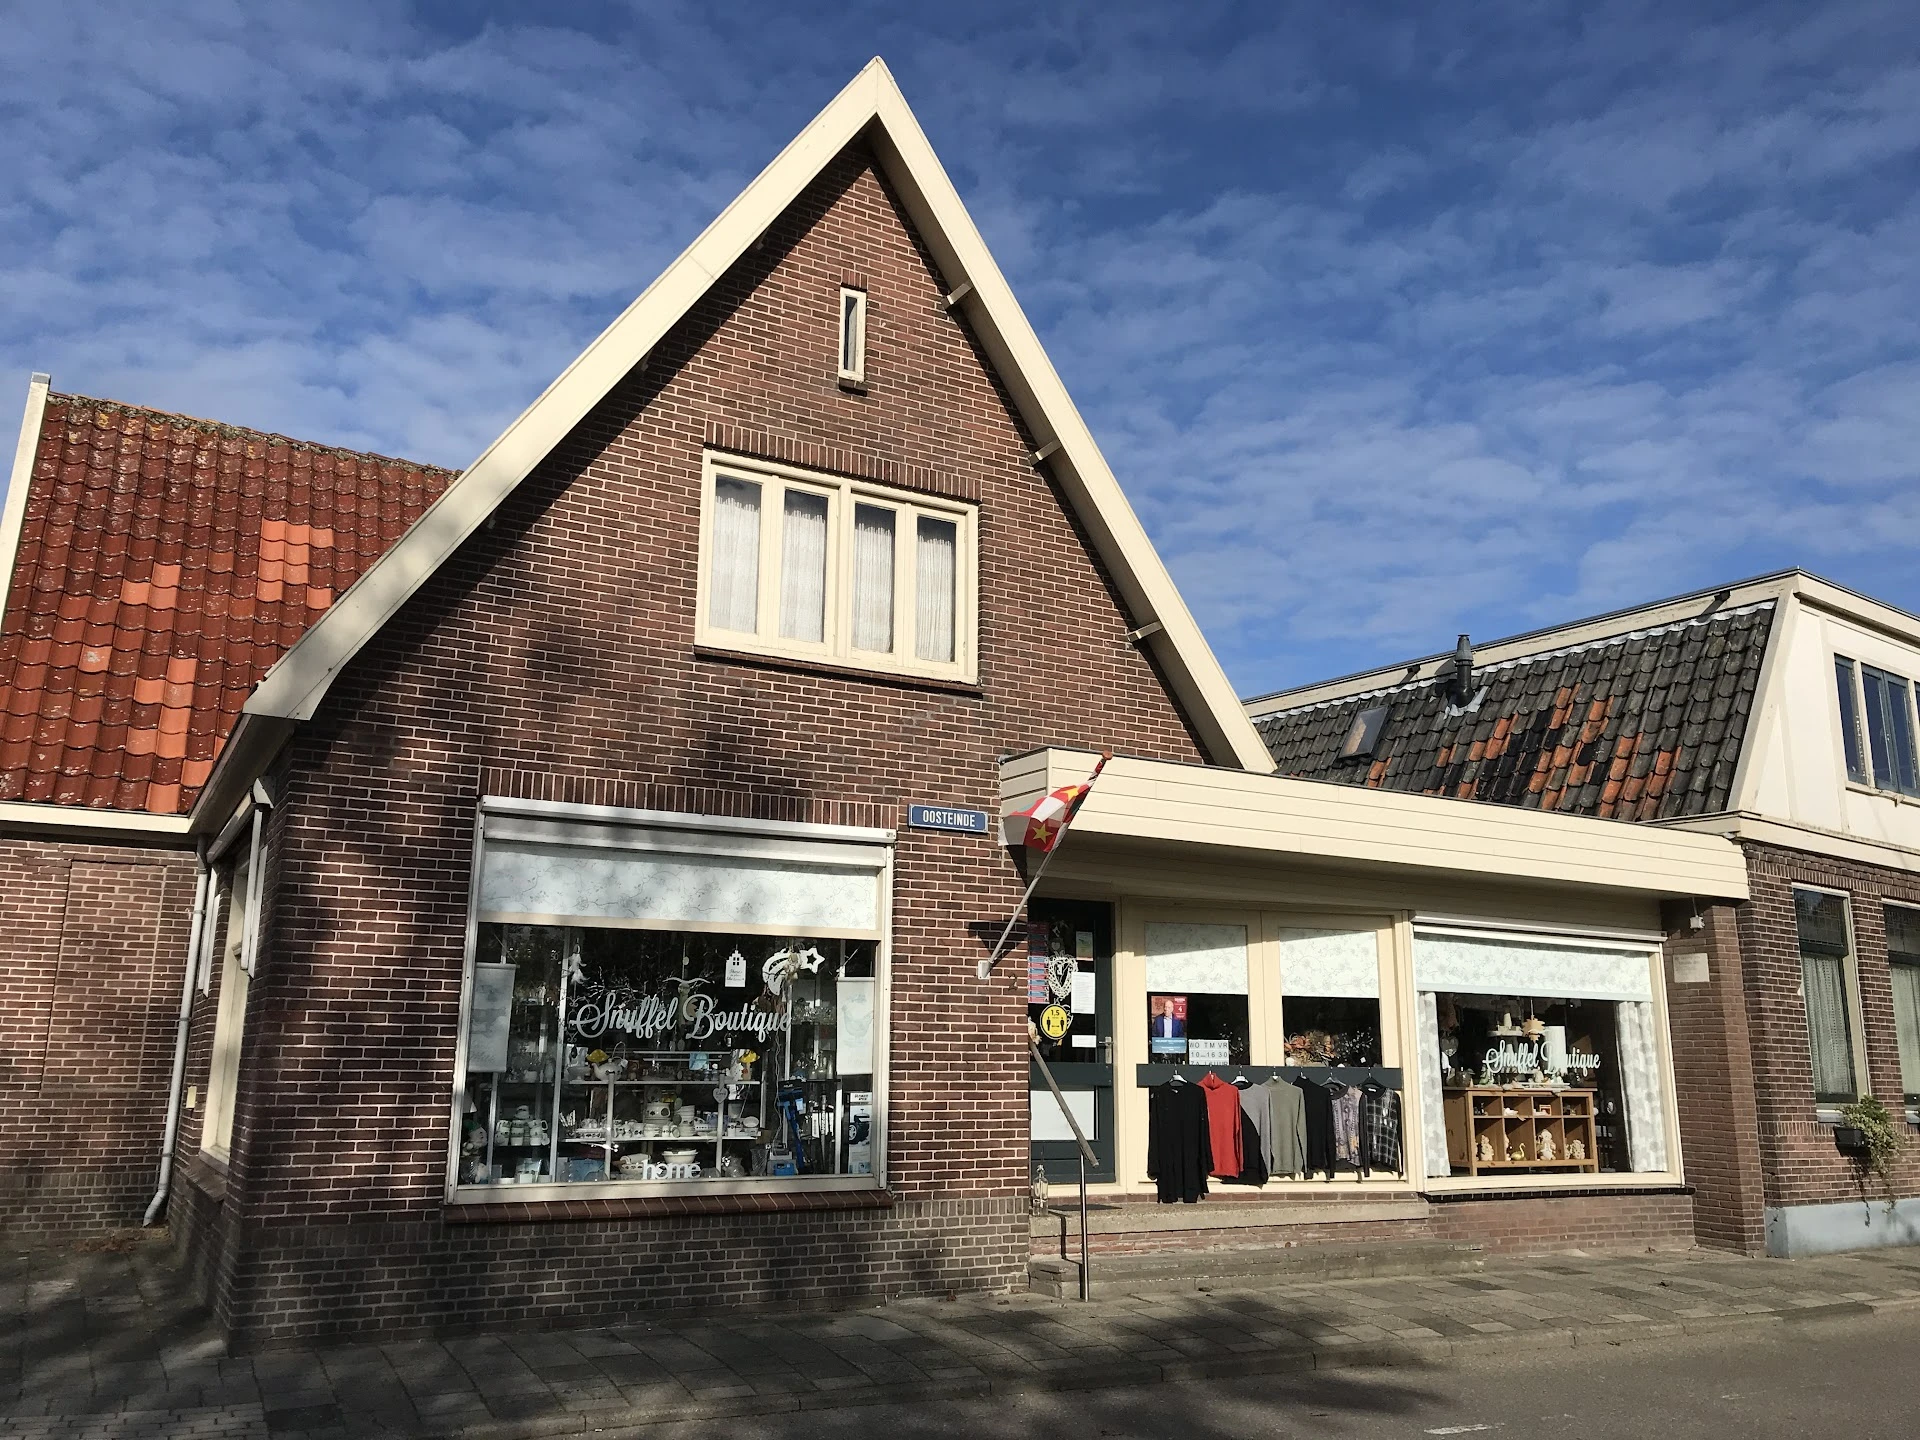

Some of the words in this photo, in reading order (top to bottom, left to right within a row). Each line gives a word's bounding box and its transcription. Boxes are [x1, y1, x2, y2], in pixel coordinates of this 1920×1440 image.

[922, 809, 976, 828] OOSTEINDE
[1008, 973, 1018, 991] 2
[569, 992, 679, 1039] Snuffel
[682, 993, 792, 1043] Boutique
[1482, 1039, 1540, 1074] Snuffel
[641, 1159, 701, 1180] home
